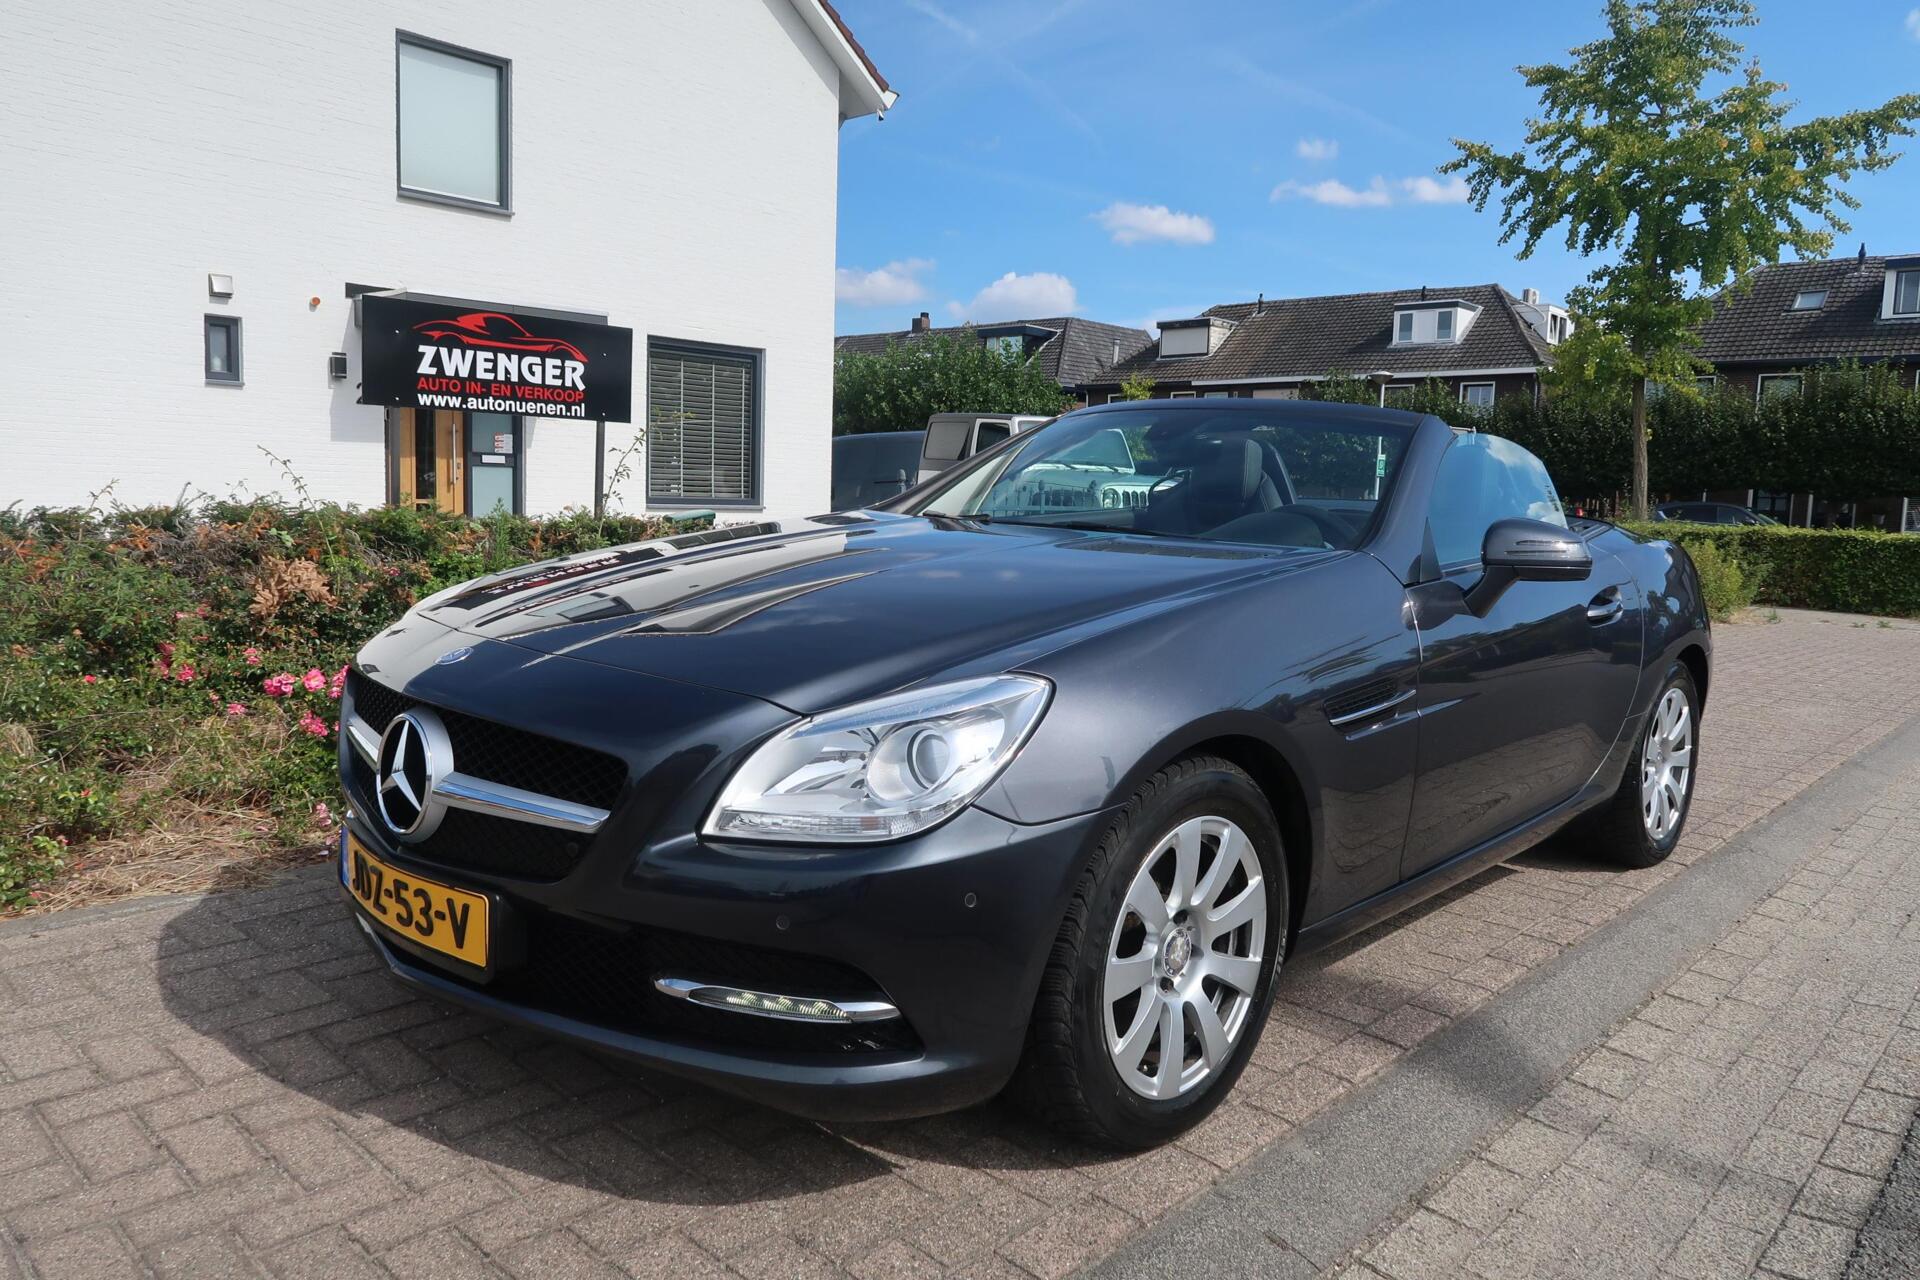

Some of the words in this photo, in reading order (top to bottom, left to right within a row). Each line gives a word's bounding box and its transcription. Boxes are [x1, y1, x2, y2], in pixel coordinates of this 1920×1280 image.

[416, 344, 586, 391] ZWENGER
[416, 377, 461, 393] AUTO
[465, 381, 487, 395] IN-
[491, 383, 512, 397] EN
[515, 386, 584, 403] VERKOOP
[417, 393, 585, 417] www.autonuenen.nl
